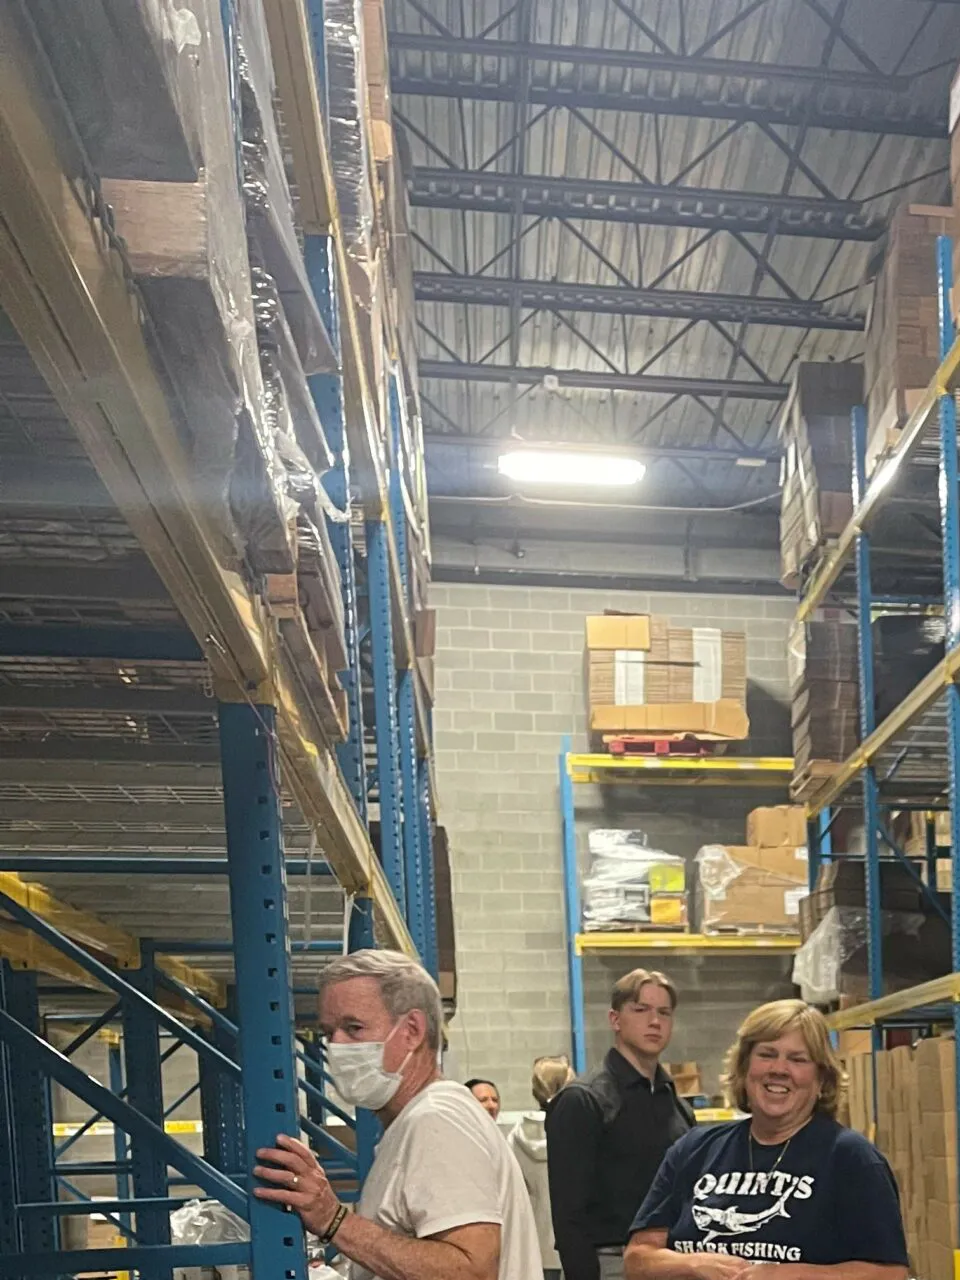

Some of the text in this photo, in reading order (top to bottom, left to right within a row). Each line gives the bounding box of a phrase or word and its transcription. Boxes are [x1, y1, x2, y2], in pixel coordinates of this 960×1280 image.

[693, 1170, 815, 1200] QUINT'S
[674, 1240, 801, 1261] SHARK FISHING
